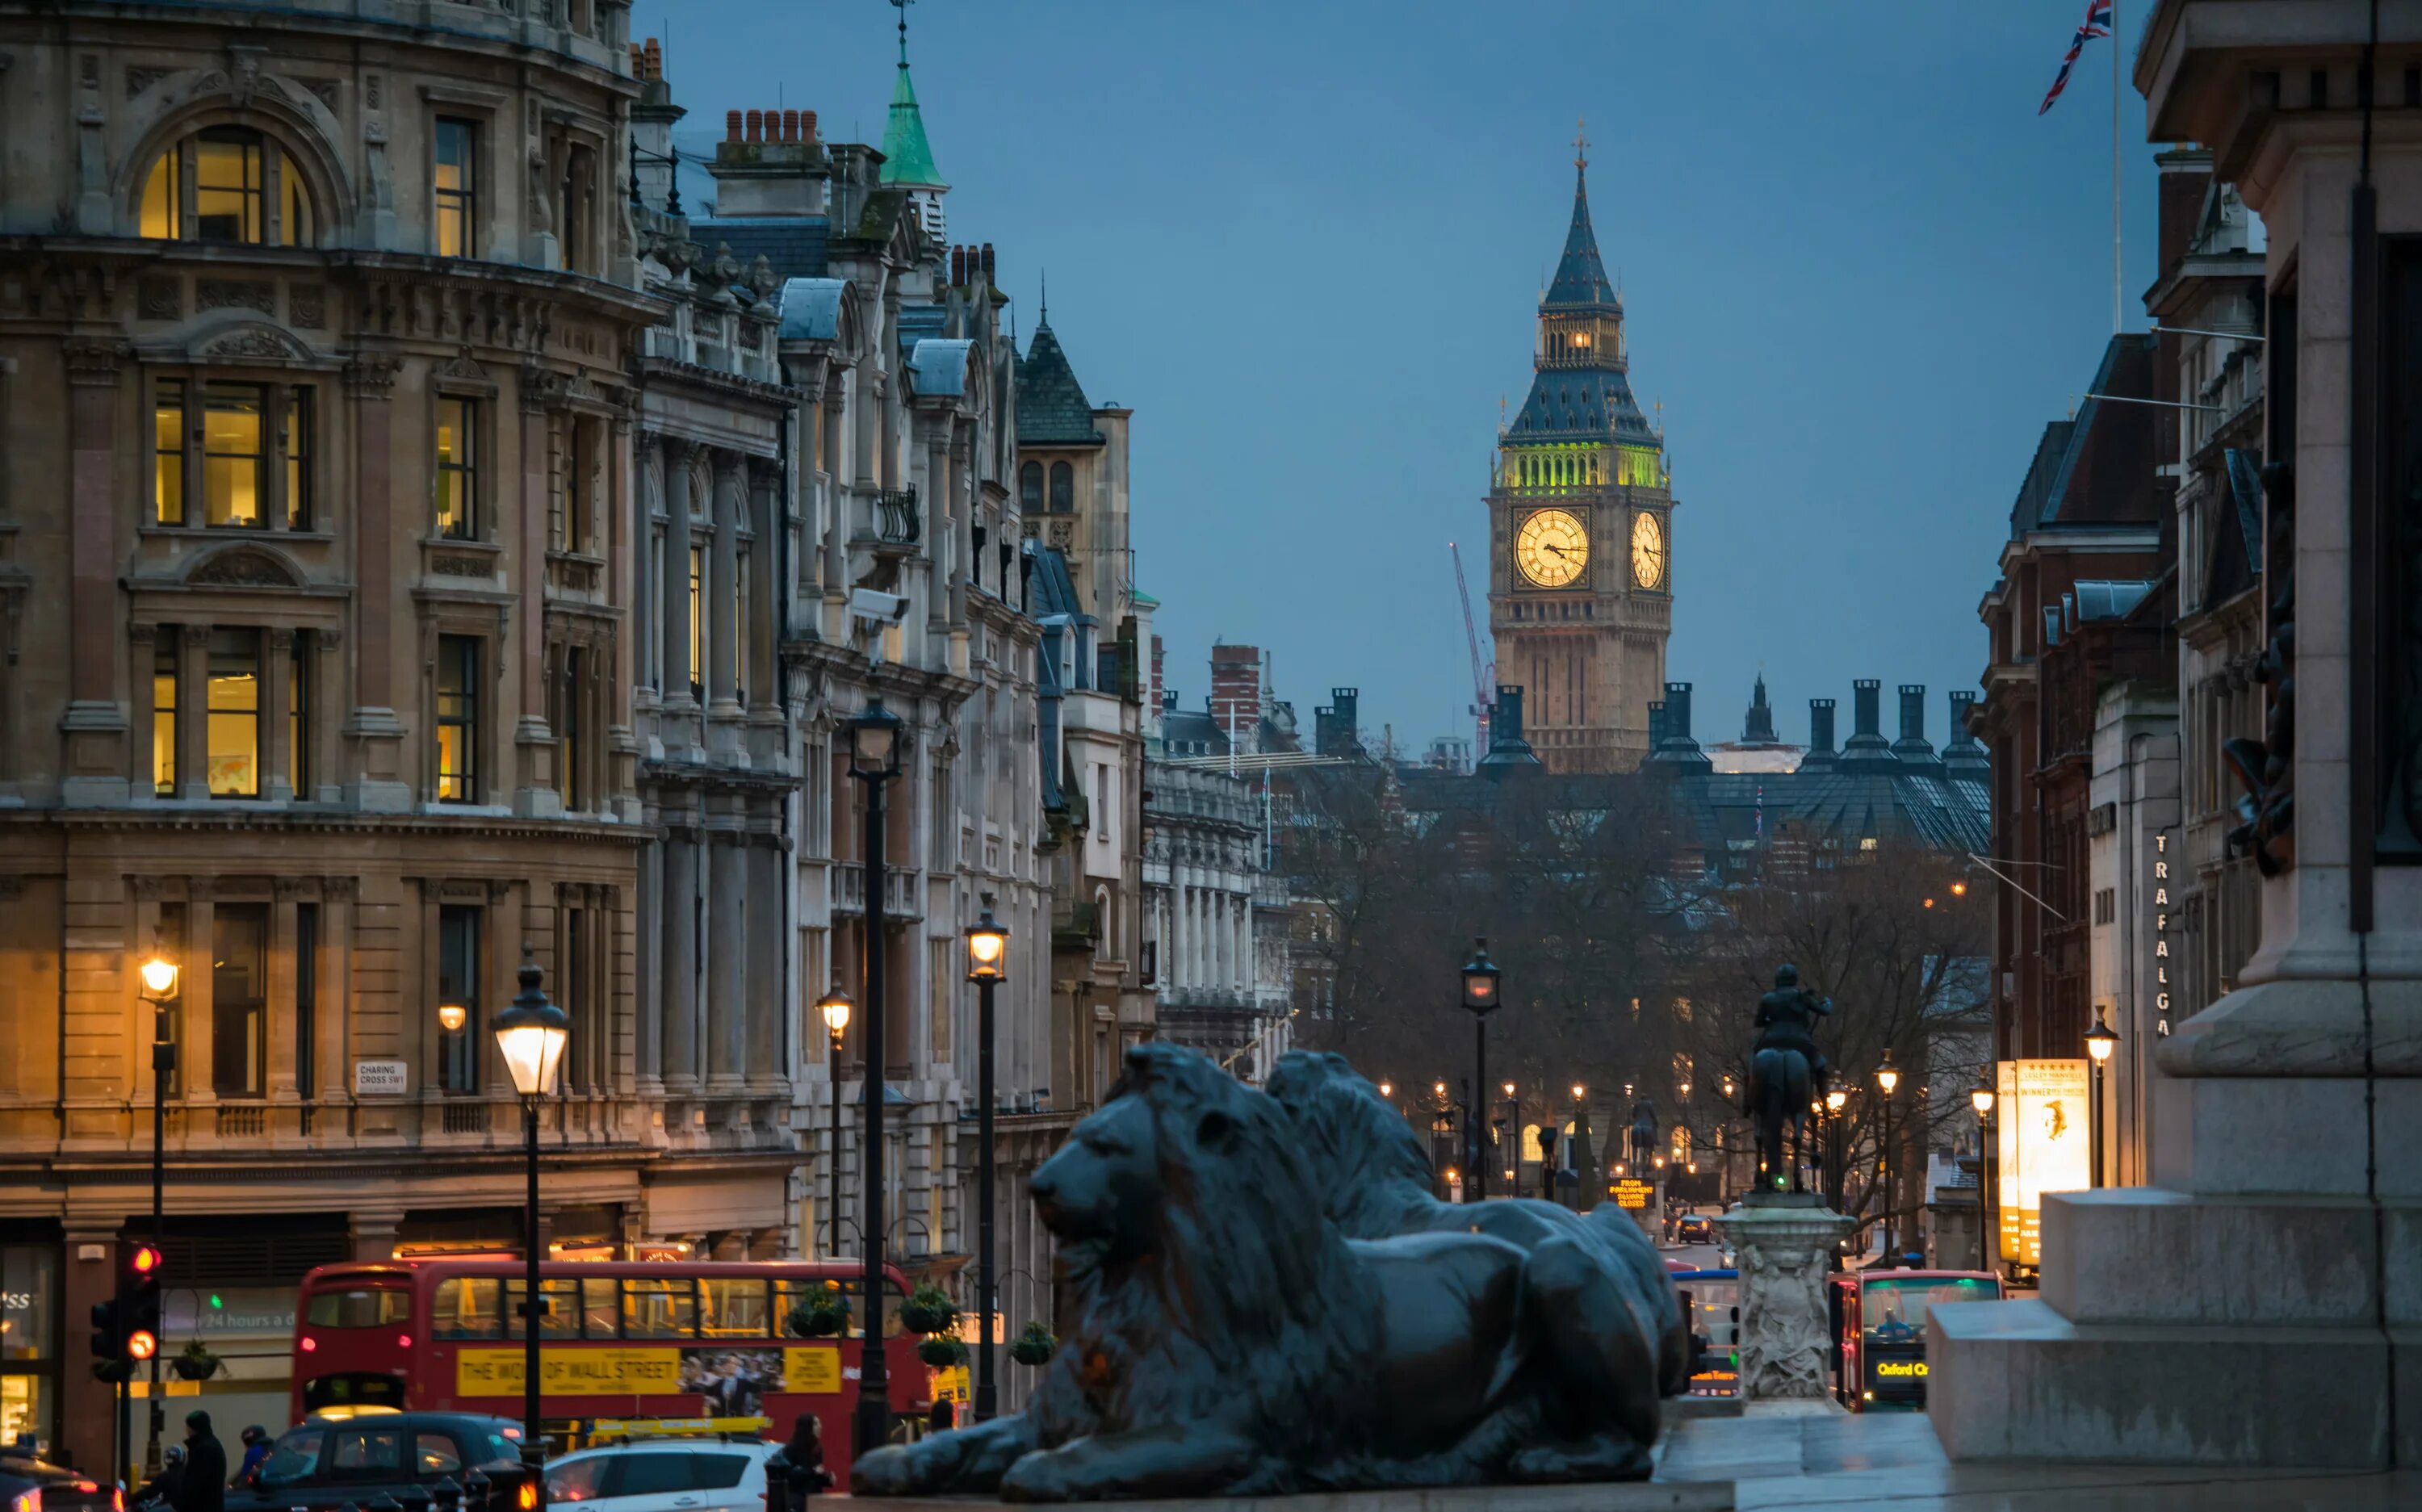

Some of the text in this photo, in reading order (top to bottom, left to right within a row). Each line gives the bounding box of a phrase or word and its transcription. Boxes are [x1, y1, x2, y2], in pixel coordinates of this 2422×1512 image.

[361, 1066, 395, 1074] CHARING
[361, 1075, 404, 1083] CROSS SW1
[2021, 1088, 2051, 1096] WINNER
[207, 1313, 223, 1327] 24
[228, 1311, 269, 1327] hours
[273, 1316, 283, 1326] a
[463, 1362, 493, 1380] THE
[545, 1361, 564, 1379] OF
[569, 1361, 611, 1379] WALL
[615, 1361, 673, 1379] STREET
[1877, 1363, 1913, 1376] Oxford
